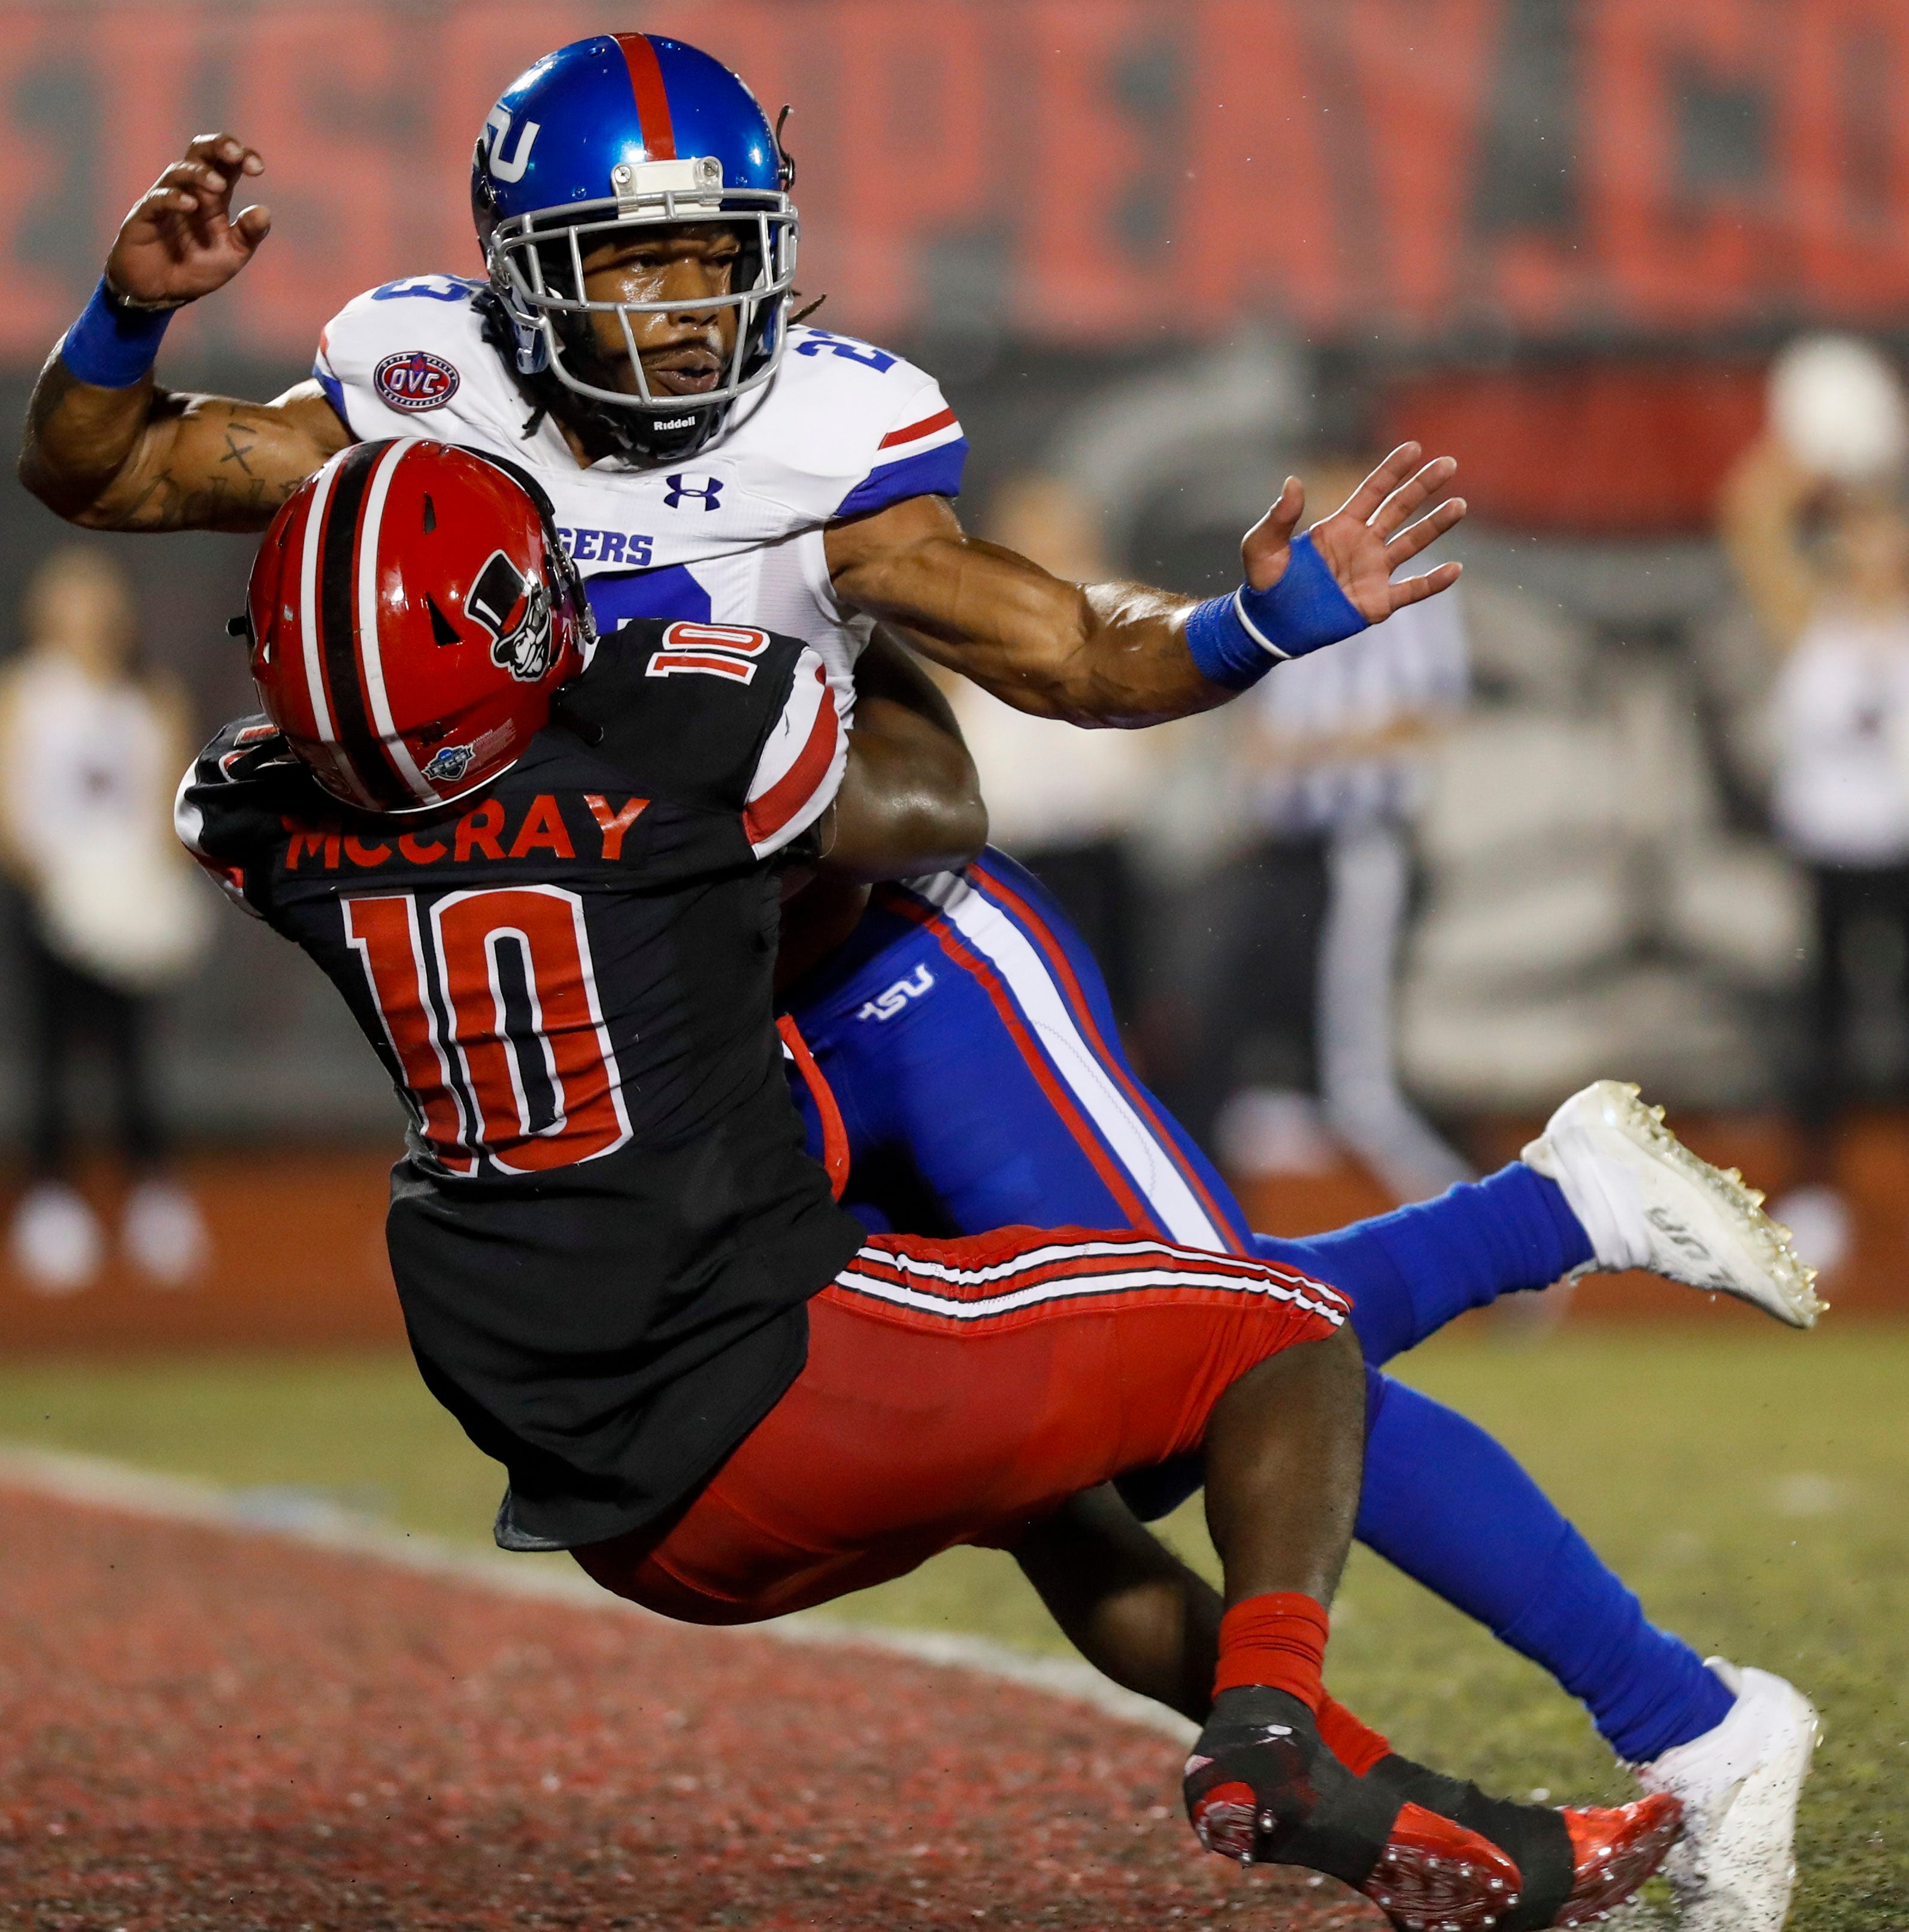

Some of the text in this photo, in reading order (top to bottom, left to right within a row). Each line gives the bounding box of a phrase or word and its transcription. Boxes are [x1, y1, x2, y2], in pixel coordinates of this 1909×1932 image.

[390, 369, 440, 393] OVC
[654, 416, 695, 430] Riddell
[645, 621, 771, 686] 10
[340, 884, 634, 1178] 10
